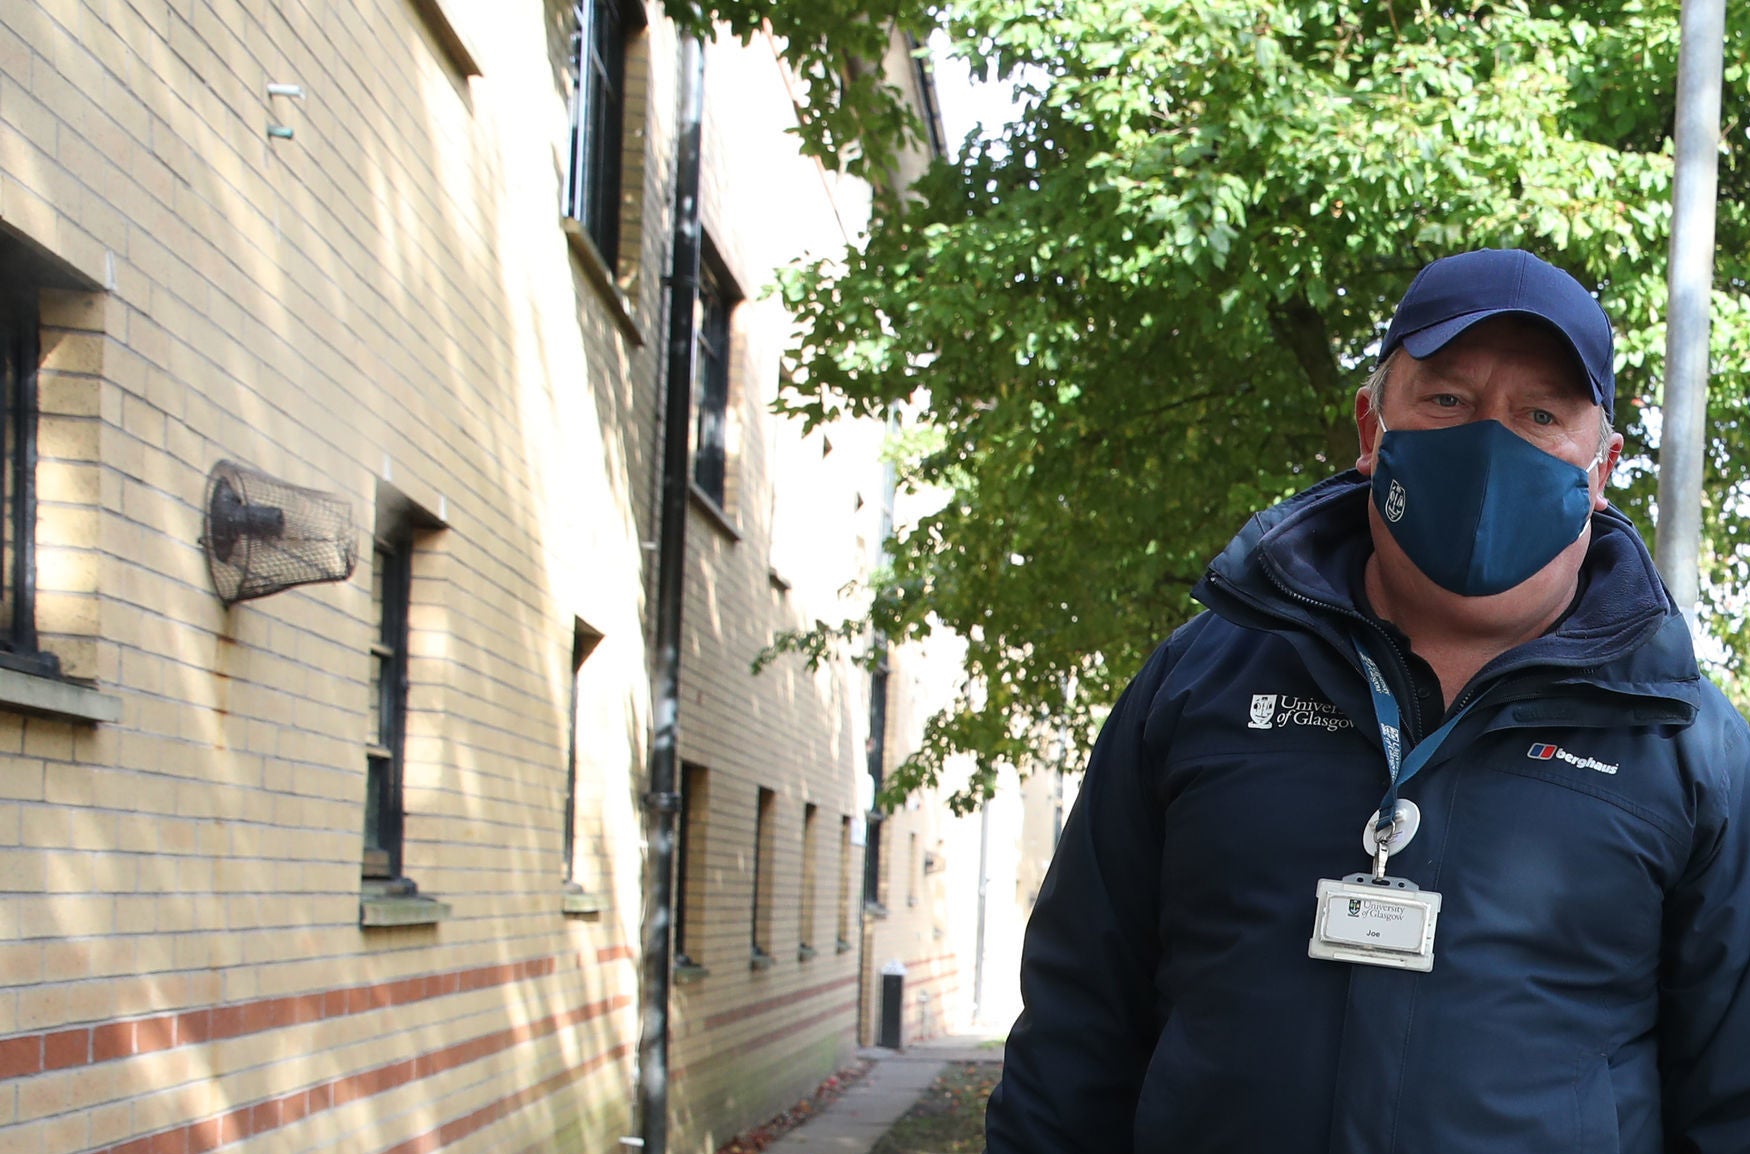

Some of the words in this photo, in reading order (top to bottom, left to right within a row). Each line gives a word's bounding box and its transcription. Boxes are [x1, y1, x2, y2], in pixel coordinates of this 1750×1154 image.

[1276, 709, 1296, 728] of
[1555, 748, 1618, 774] berghaus
[1363, 899, 1405, 914] University
[1370, 909, 1405, 921] Glasgow
[1366, 929, 1381, 938] Joe
